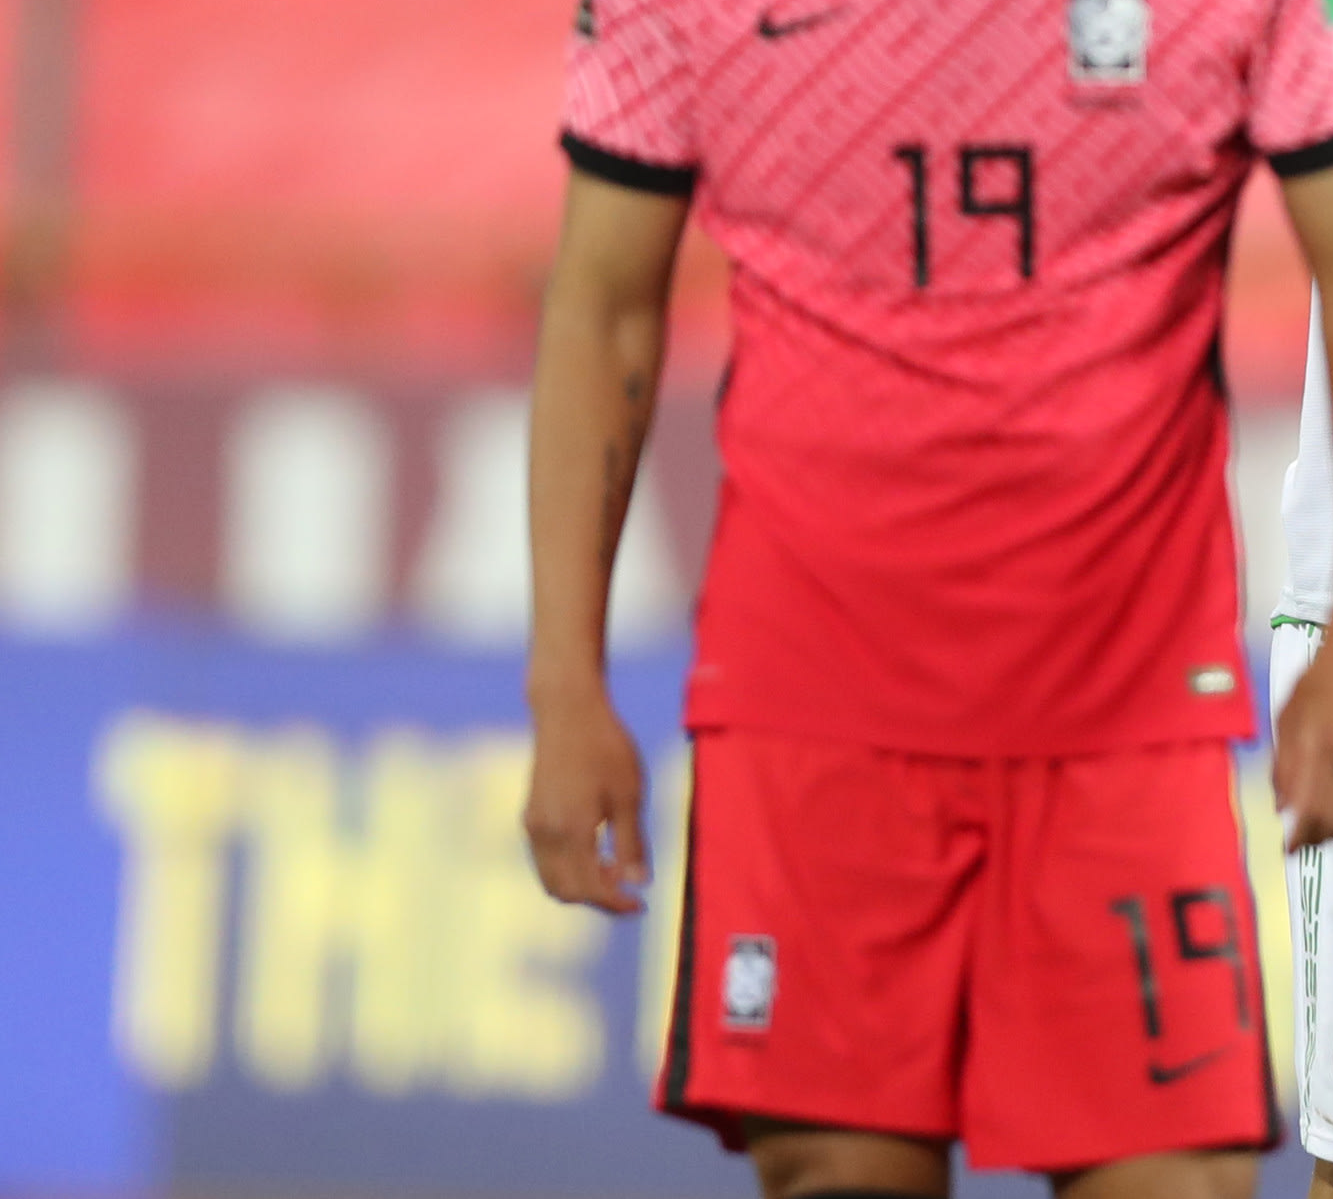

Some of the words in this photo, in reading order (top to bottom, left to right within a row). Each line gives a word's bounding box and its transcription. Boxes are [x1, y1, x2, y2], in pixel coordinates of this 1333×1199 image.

[891, 142, 1037, 287] 19
[98, 713, 598, 1096] THE
[1108, 887, 1251, 1037] 19
